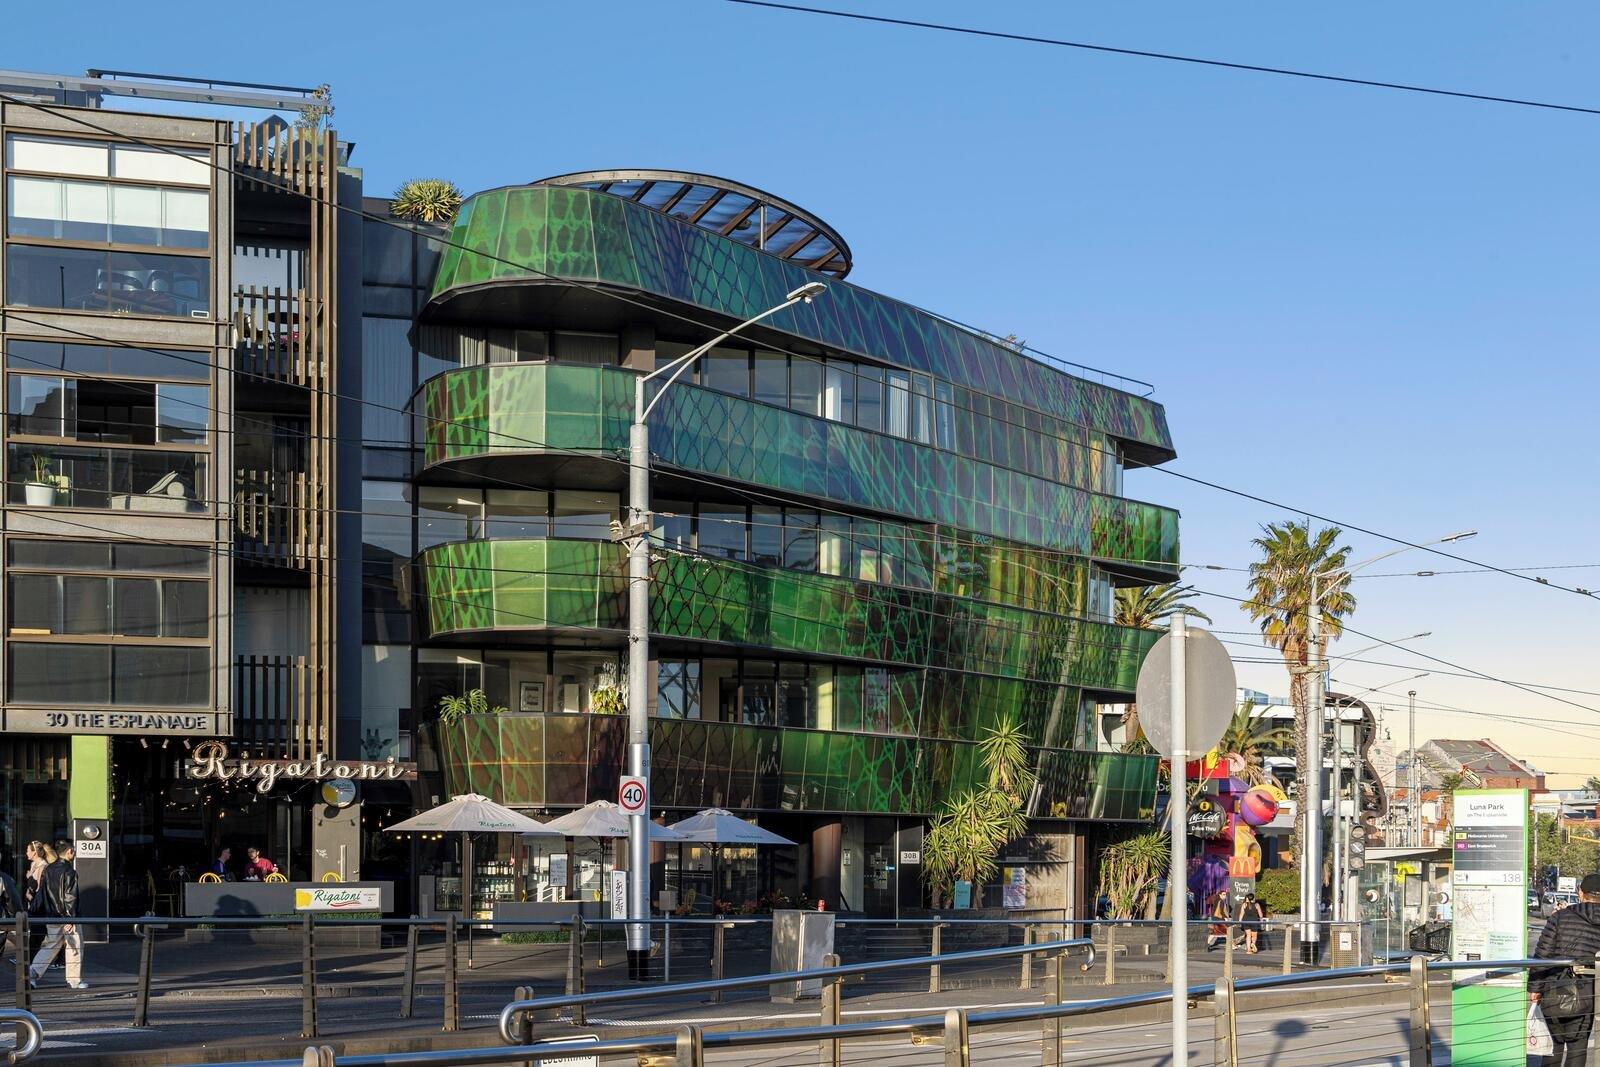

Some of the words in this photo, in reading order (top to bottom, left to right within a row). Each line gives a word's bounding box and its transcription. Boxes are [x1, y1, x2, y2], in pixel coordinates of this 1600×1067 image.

[46, 713, 68, 727] 30
[72, 713, 104, 728] THE
[109, 713, 207, 730] ESPLANADE
[191, 740, 405, 793] Rigatoni
[624, 788, 642, 803] 40
[479, 821, 515, 829] Rigatoni
[609, 826, 629, 834] Riga
[81, 842, 102, 851] 30A
[1503, 873, 1521, 882] 138
[314, 889, 362, 905] Rigatoni
